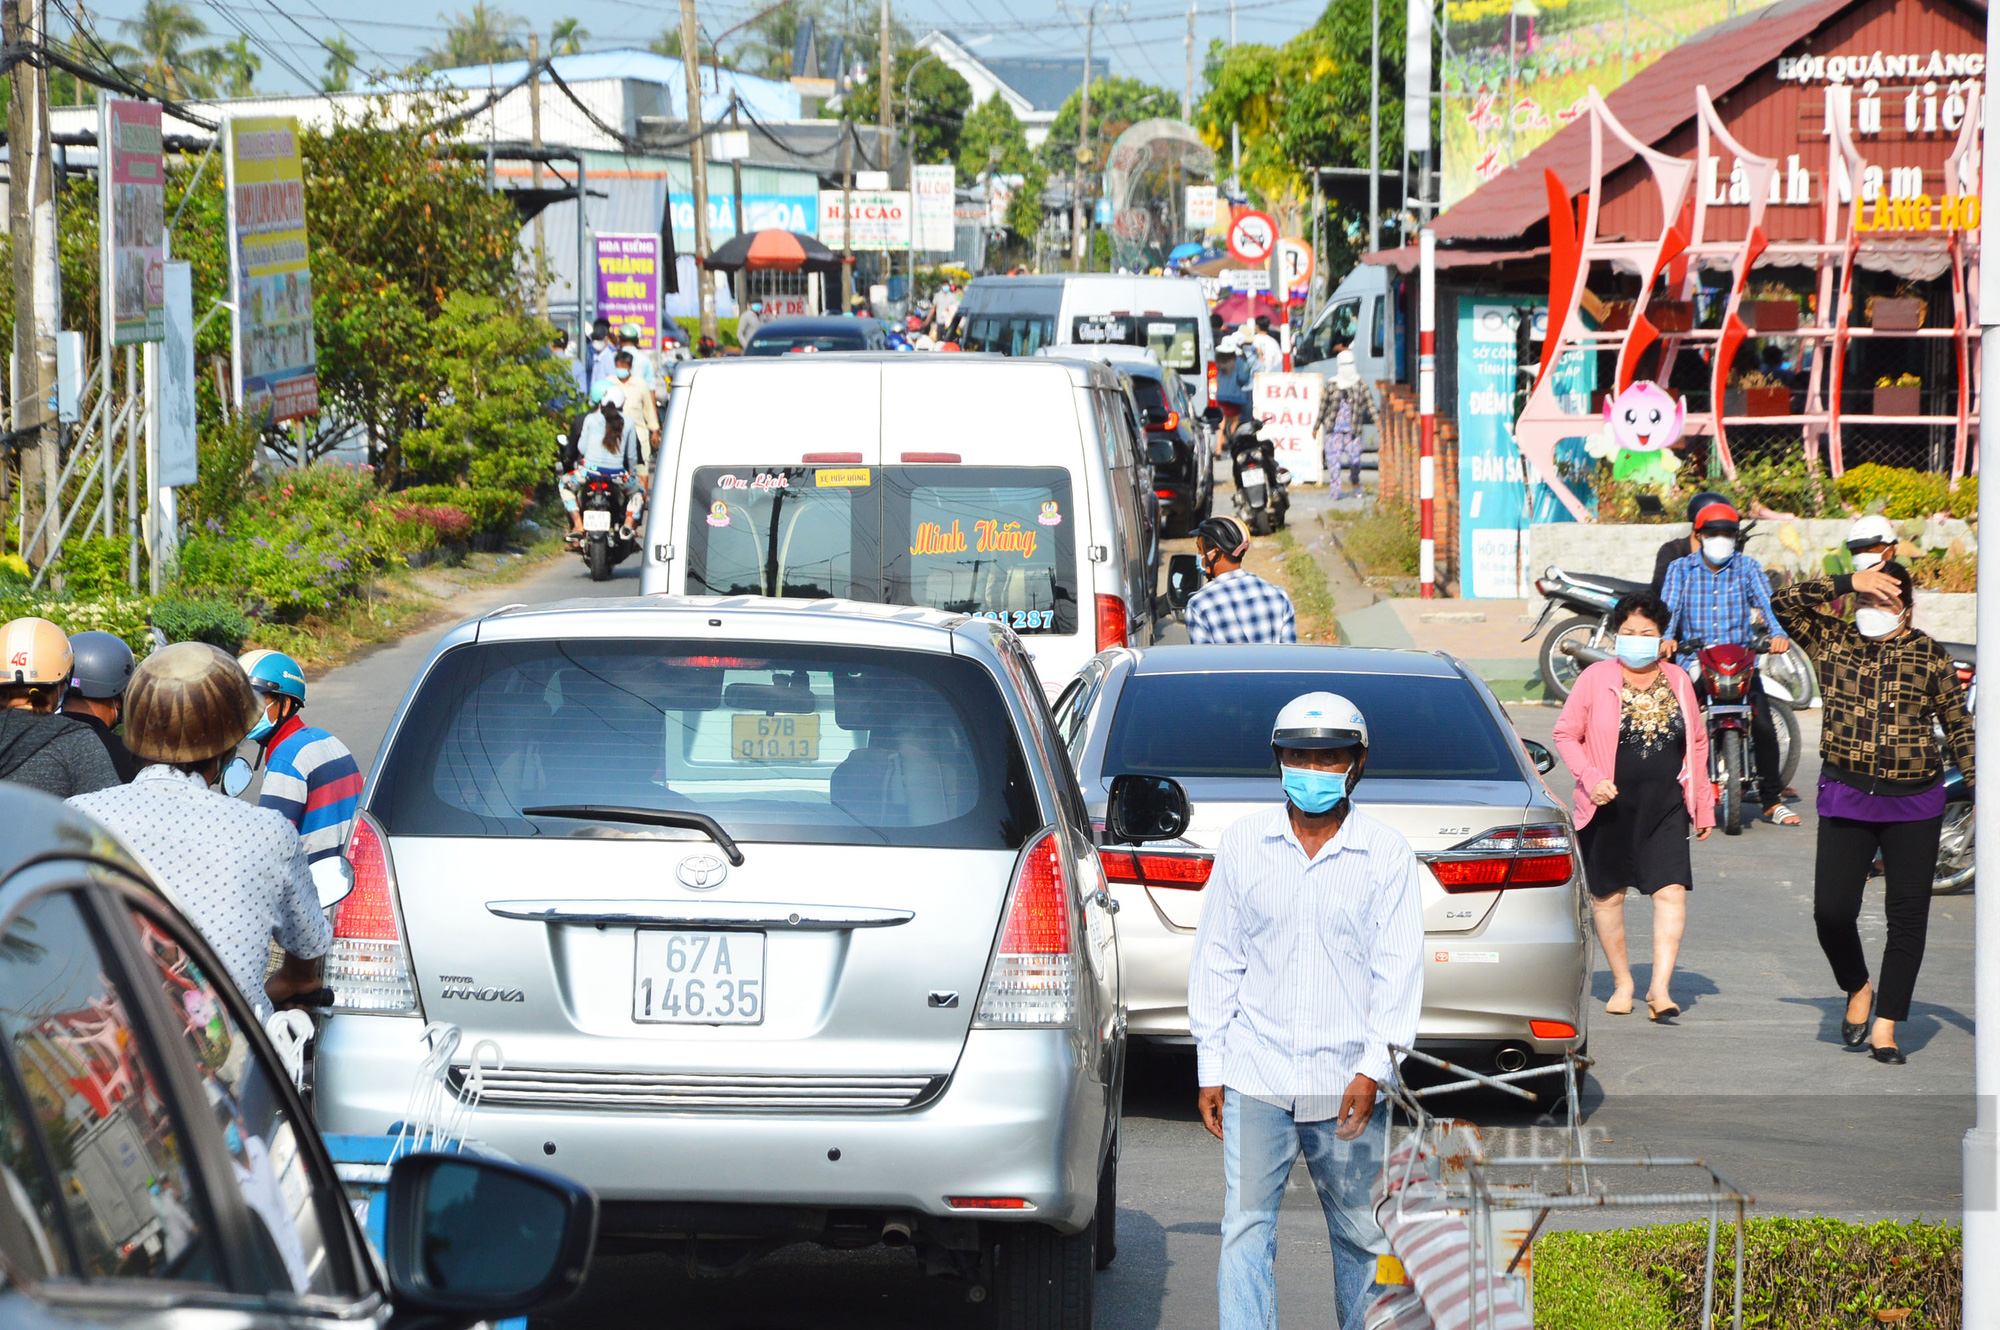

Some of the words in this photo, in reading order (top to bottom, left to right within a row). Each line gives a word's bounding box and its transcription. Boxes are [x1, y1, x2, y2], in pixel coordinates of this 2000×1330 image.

[1905, 78, 1986, 133] tiế
[865, 206, 902, 219] CAO
[1855, 185, 1932, 232] LÀNG
[1266, 381, 1309, 400] BÃI
[1273, 437, 1302, 452] XE
[1472, 449, 1505, 482] BÁN
[717, 474, 749, 491] Du
[751, 472, 790, 493] Lịch
[820, 474, 830, 484] XE
[910, 519, 967, 555] Minh
[11, 651, 29, 667] 4G
[758, 717, 795, 736] 67B
[742, 739, 810, 757] 010.13
[665, 935, 733, 975] 67A
[439, 975, 474, 985] TOYOTA
[441, 984, 525, 1003] INNOVA
[640, 977, 760, 1018] 146.35
